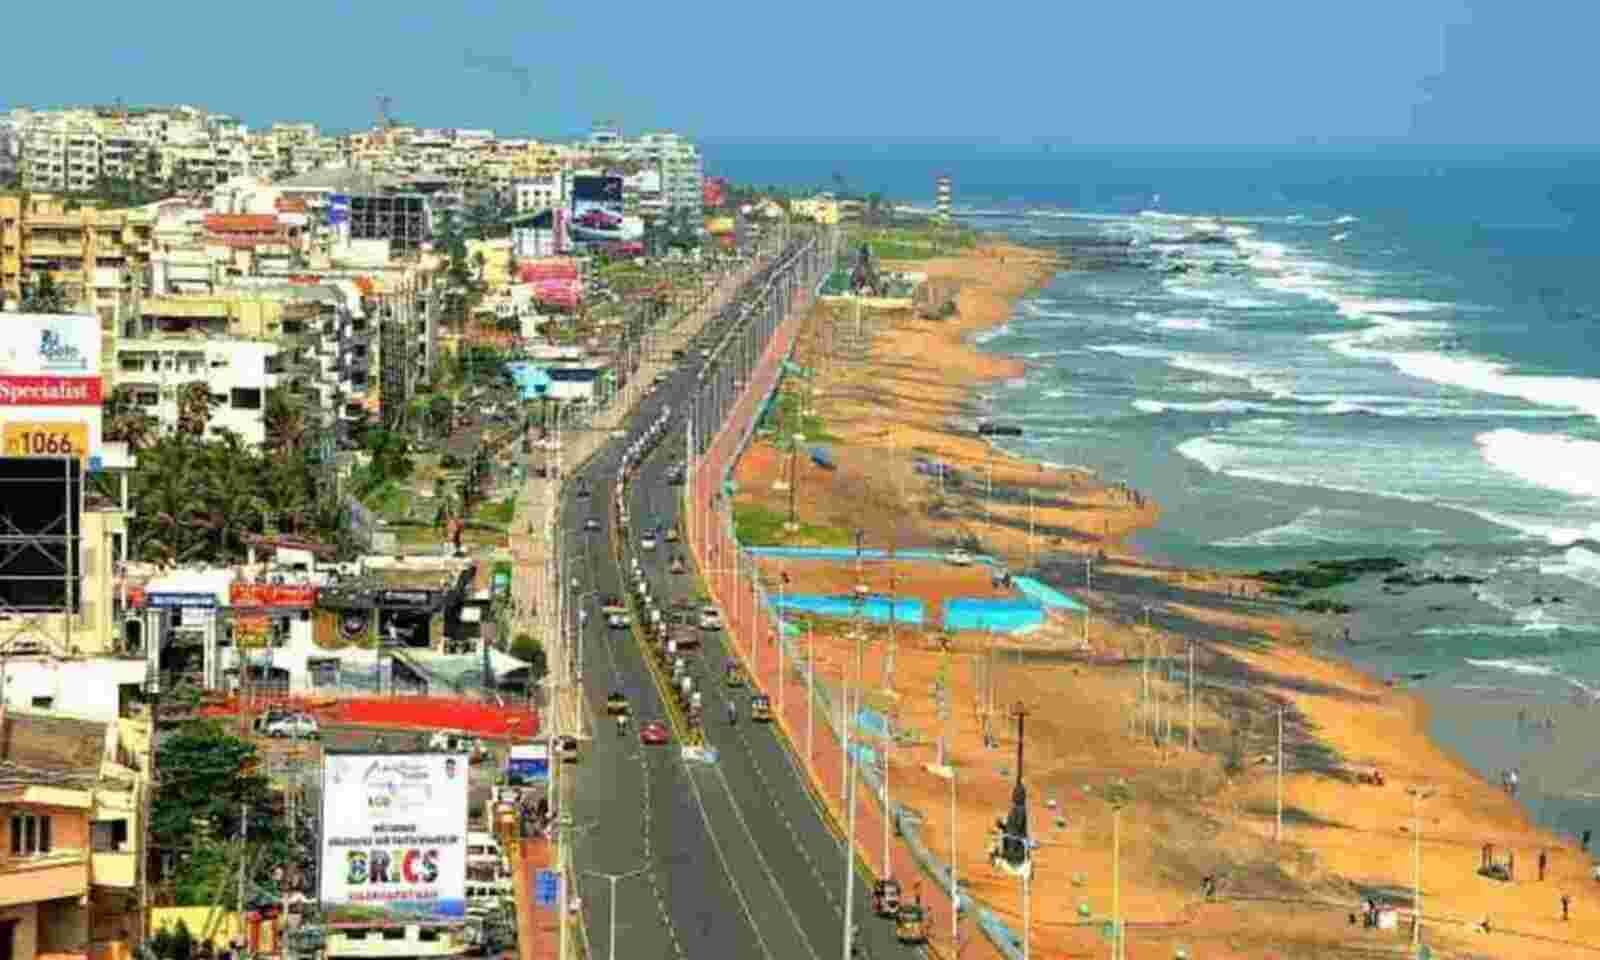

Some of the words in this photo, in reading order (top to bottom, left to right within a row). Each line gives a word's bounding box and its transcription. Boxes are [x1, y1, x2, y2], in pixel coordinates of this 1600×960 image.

[0, 382, 87, 403] Specialist
[21, 431, 72, 454] 1066
[346, 849, 439, 884] BRICS
